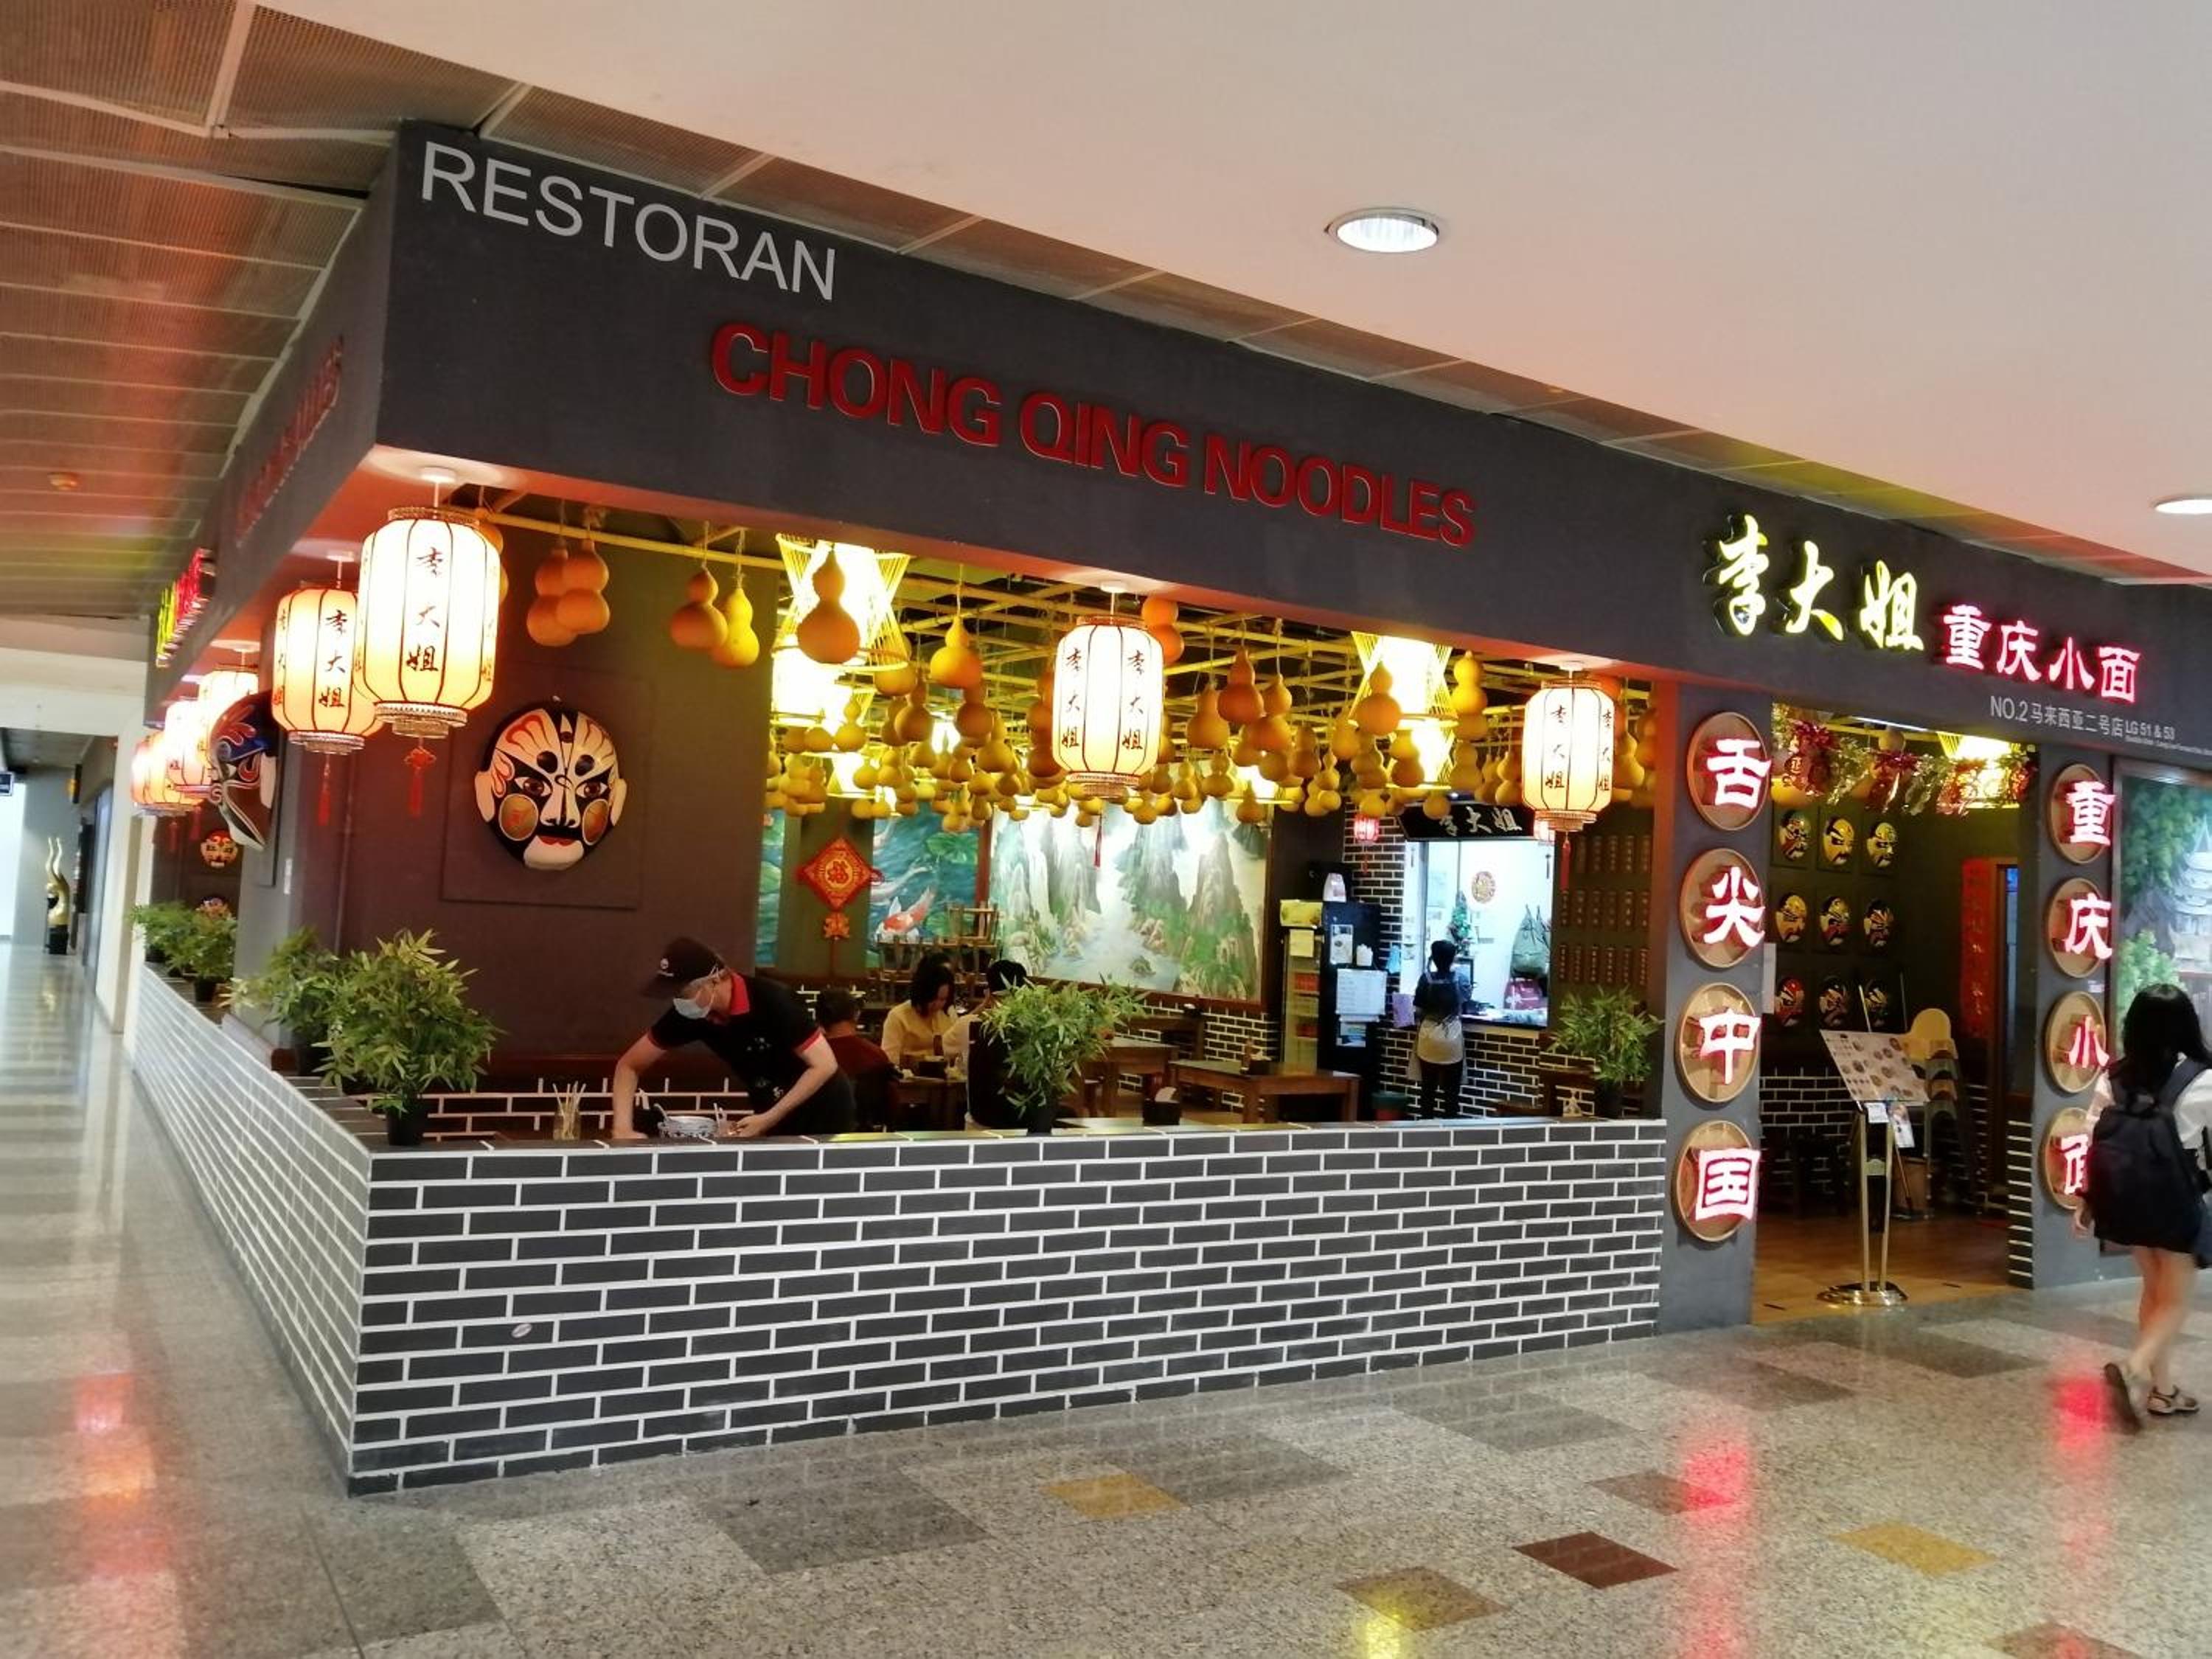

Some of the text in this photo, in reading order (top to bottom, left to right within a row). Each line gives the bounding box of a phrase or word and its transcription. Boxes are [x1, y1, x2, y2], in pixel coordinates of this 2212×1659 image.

[421, 141, 836, 301] RESTORAN
[711, 321, 1475, 548] CHONG QING NOODLES
[1717, 514, 2140, 704] 李大姐 重庆小面
[1990, 695, 2028, 723] NO.2
[1694, 738, 1772, 1222] 舌尖中国
